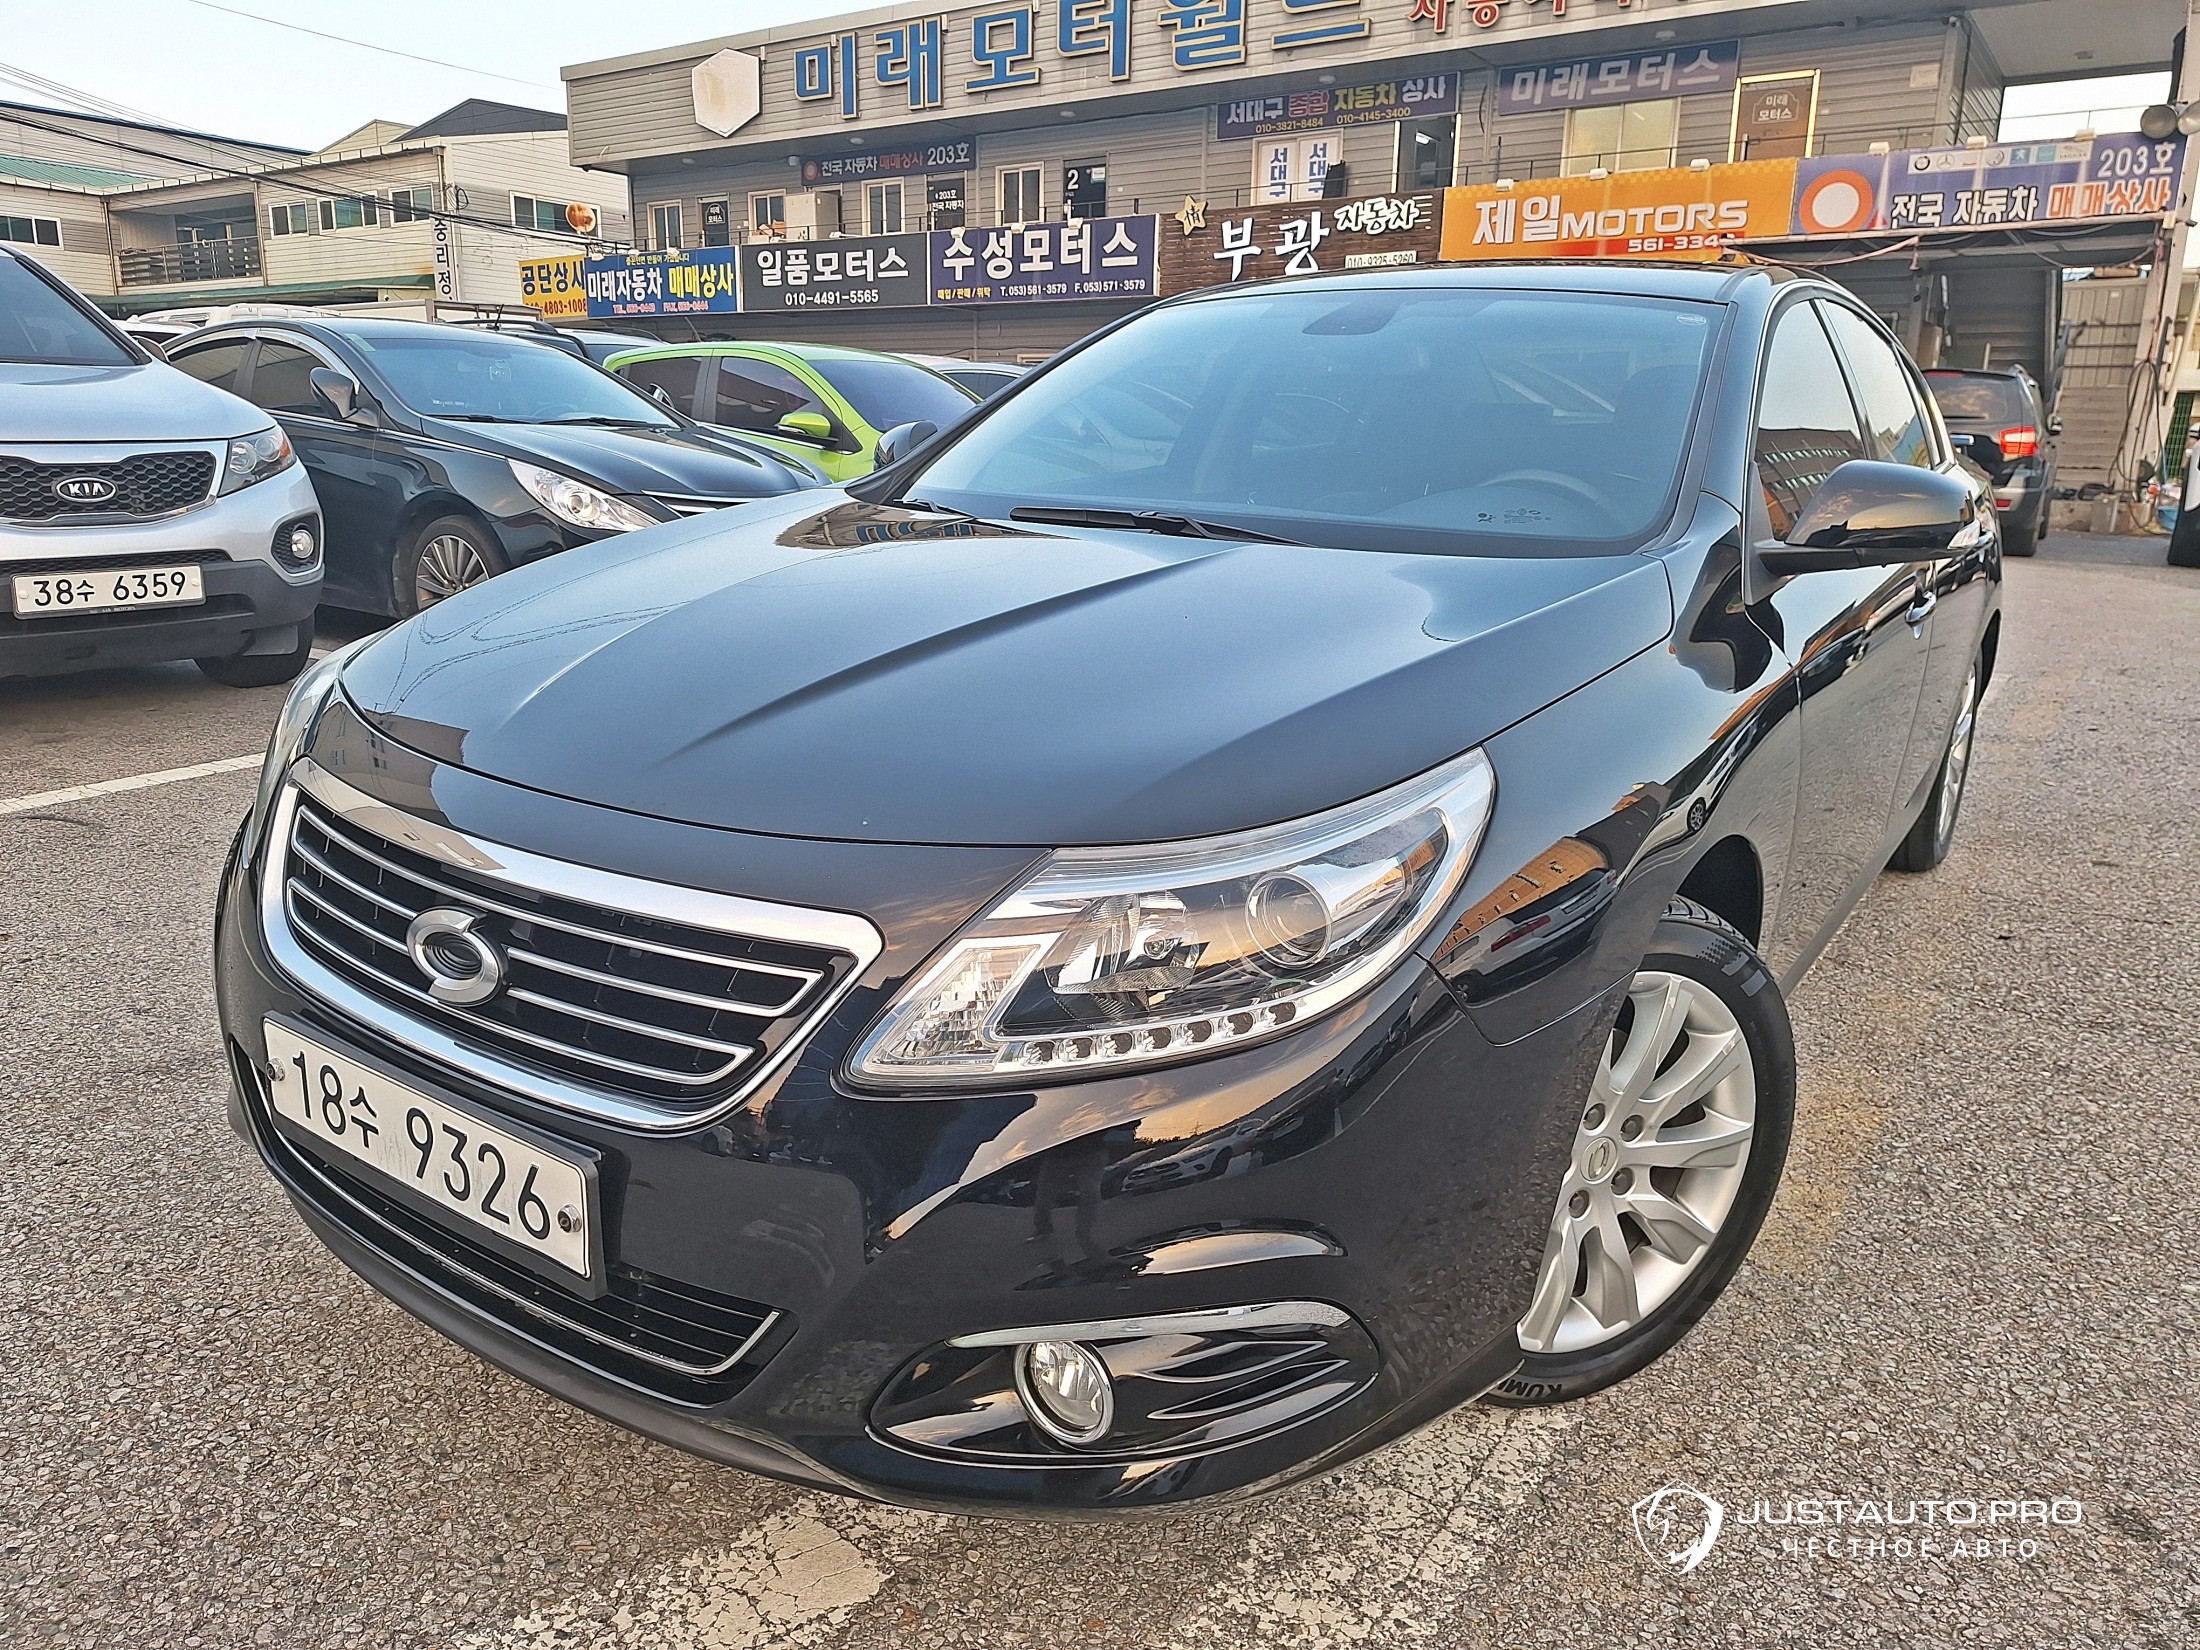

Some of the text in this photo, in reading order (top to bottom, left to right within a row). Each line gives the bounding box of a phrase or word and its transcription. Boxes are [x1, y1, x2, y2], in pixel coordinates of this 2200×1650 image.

[1511, 49, 1721, 105] 미래모터스
[1226, 75, 1446, 124] 서대구 종합 자동차 상사
[1336, 107, 1411, 125] 010-4145-3400
[1757, 107, 1793, 121] 모터스
[1765, 93, 1789, 107] 미래
[1255, 117, 1323, 134] 010-3821-8484
[821, 141, 970, 177] 전국 자동차 매매상사 203호
[2097, 141, 2177, 178] 203호
[1333, 196, 1420, 235] 자동차
[1891, 191, 1945, 230] 전국
[1952, 185, 2039, 226] 자동차
[757, 247, 910, 287] 일품모터스
[942, 222, 1139, 282] 수성모터스
[586, 262, 734, 302] 미래자동차 매매상사
[784, 289, 880, 306] 010-4491-5565
[67, 482, 106, 497] KIA
[32, 571, 186, 607] 38수 6359
[292, 1050, 551, 1240] 18수 9326
[1499, 1379, 1563, 1398] KUM
